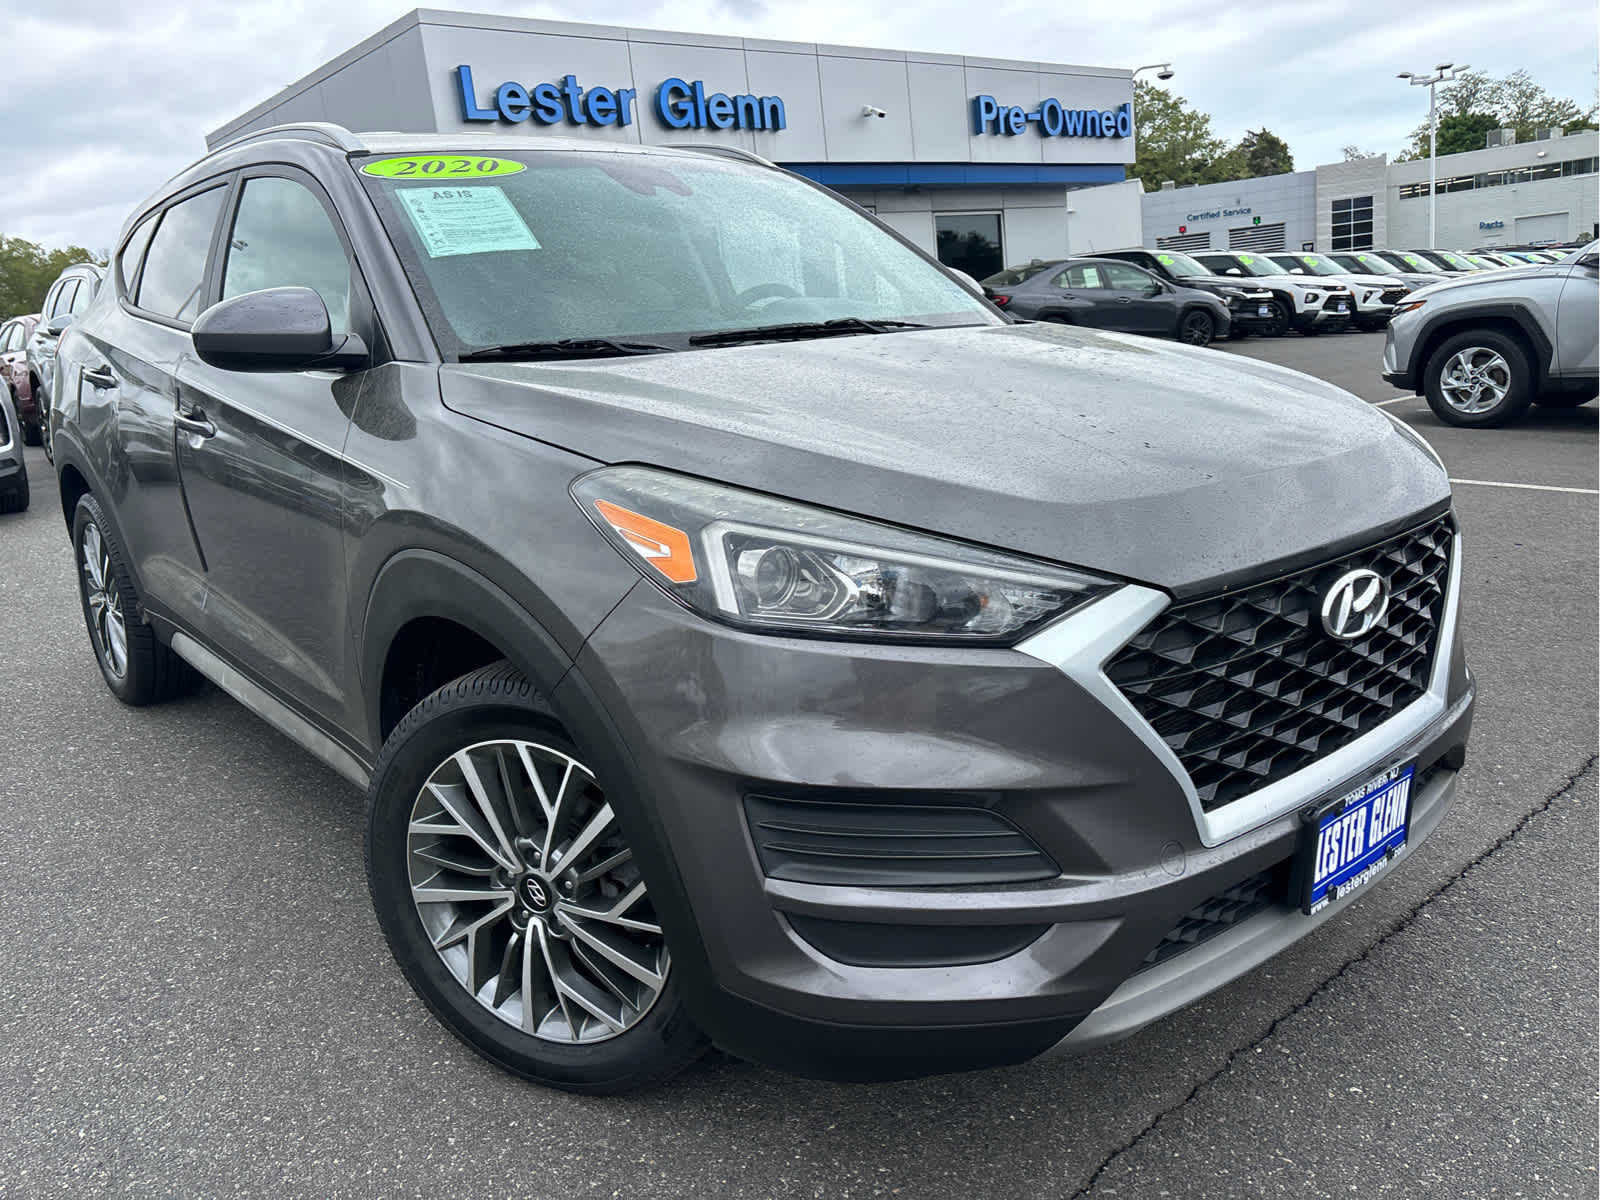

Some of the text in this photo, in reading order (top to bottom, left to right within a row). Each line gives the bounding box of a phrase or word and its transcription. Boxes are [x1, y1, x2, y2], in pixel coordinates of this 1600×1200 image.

[456, 64, 787, 130] Lester Glenn
[972, 94, 1132, 138] Pre-Owned
[394, 159, 500, 175] 2020
[433, 190, 473, 199] AS IS
[1187, 207, 1252, 222] Certified Service
[1479, 220, 1505, 230] Parts
[1314, 778, 1411, 884] LESTER GLENN
